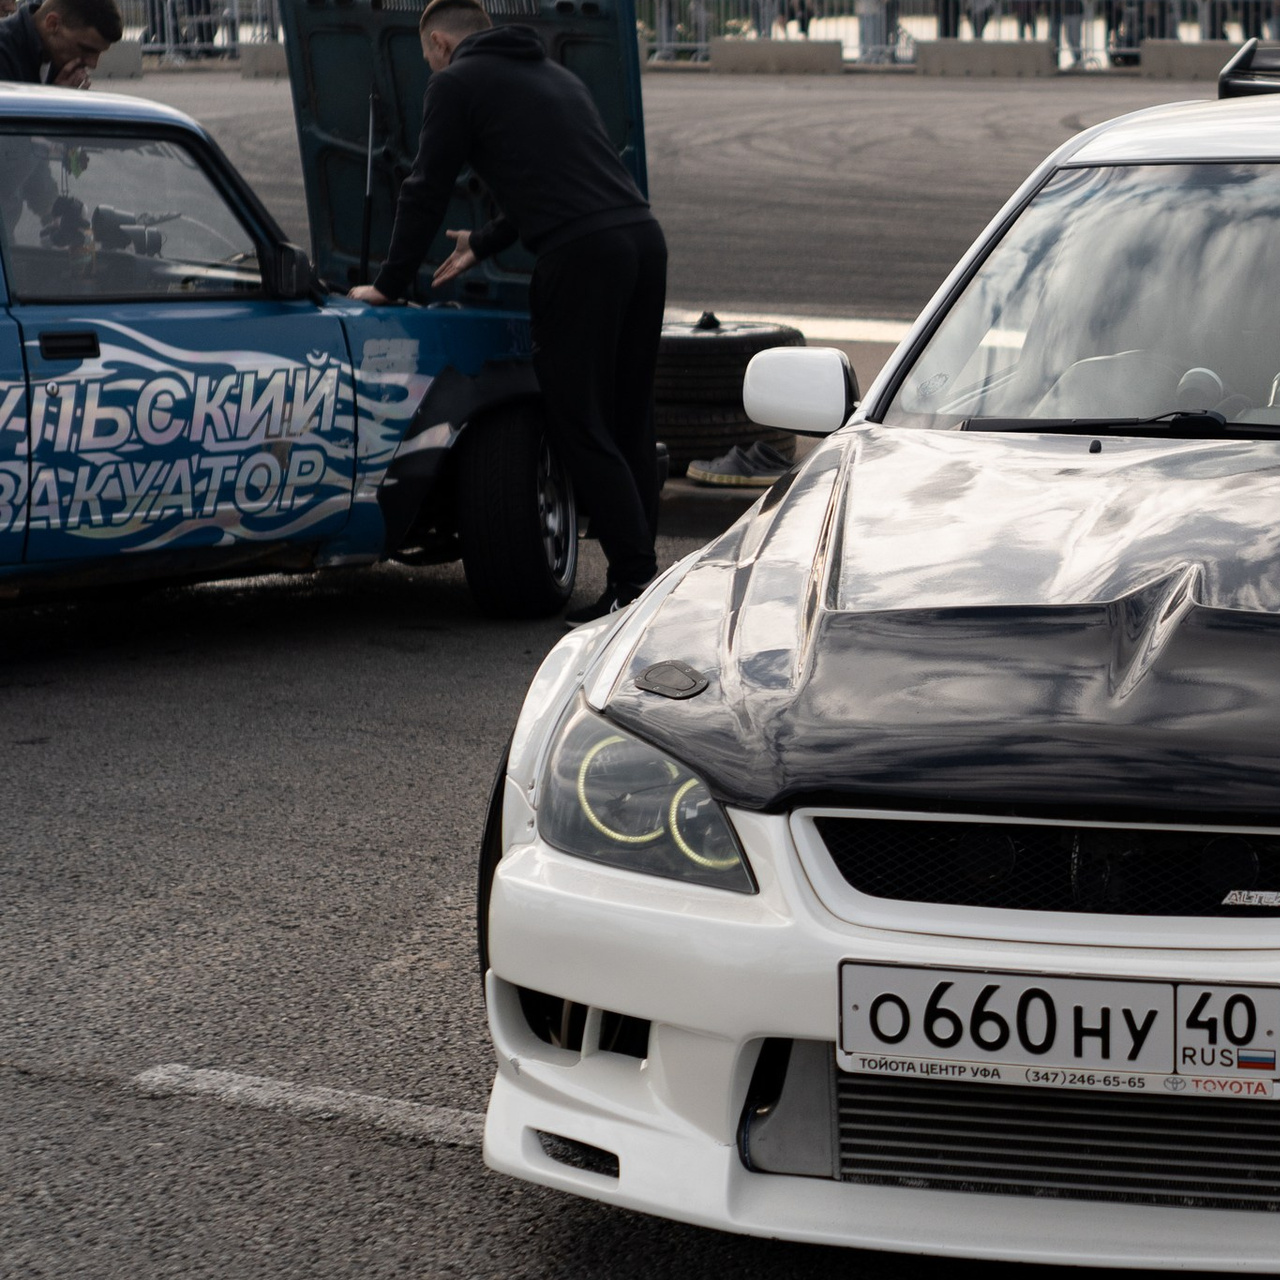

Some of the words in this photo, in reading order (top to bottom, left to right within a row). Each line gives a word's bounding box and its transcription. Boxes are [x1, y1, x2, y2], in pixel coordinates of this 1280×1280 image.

[1185, 992, 1257, 1046] 40
[859, 1057, 917, 1073] ТОЙОТА
[919, 1062, 967, 1076] ЦЕНТР
[971, 1067, 1001, 1079] УФА
[1182, 1047, 1234, 1068] RUS
[1191, 1079, 1267, 1095] TOYOTA
